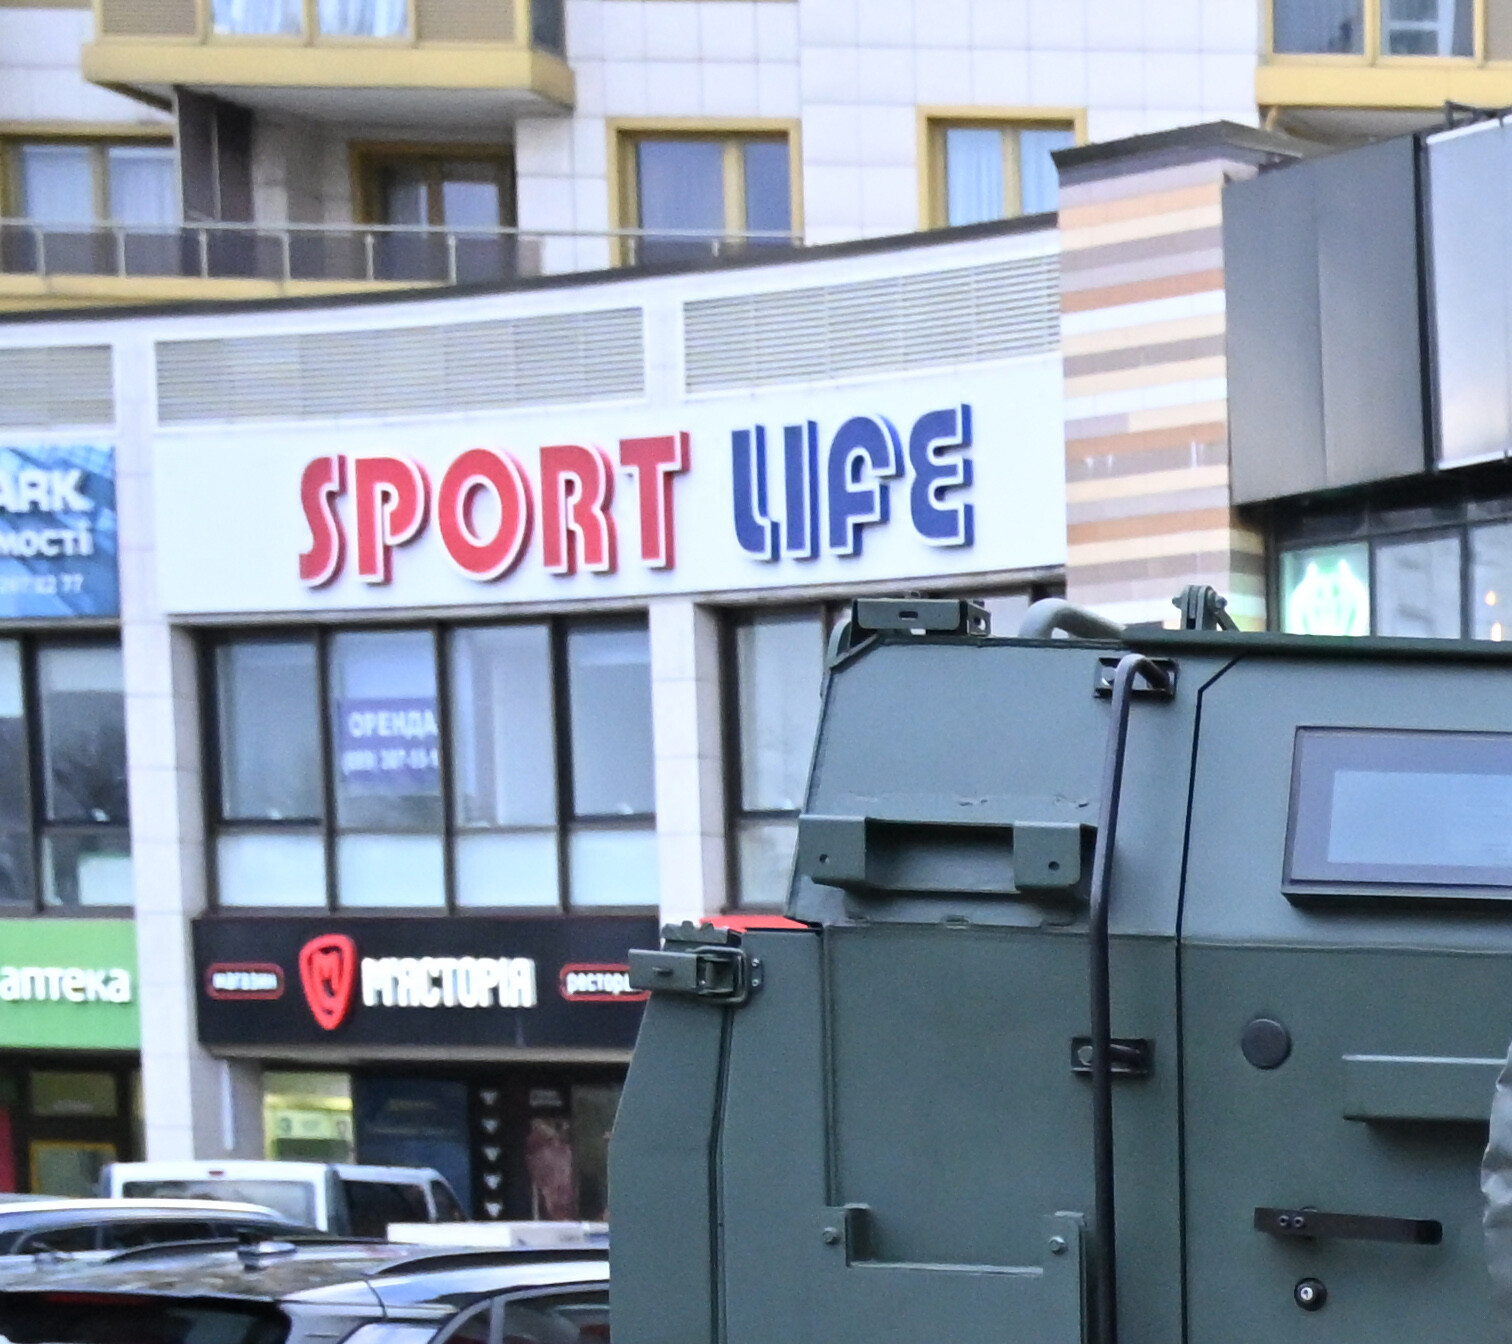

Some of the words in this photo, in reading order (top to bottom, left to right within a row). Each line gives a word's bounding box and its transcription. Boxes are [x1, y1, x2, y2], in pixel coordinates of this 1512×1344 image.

[298, 431, 691, 590] SPORT
[731, 403, 975, 563] LIFE
[0, 965, 132, 1004] аптека
